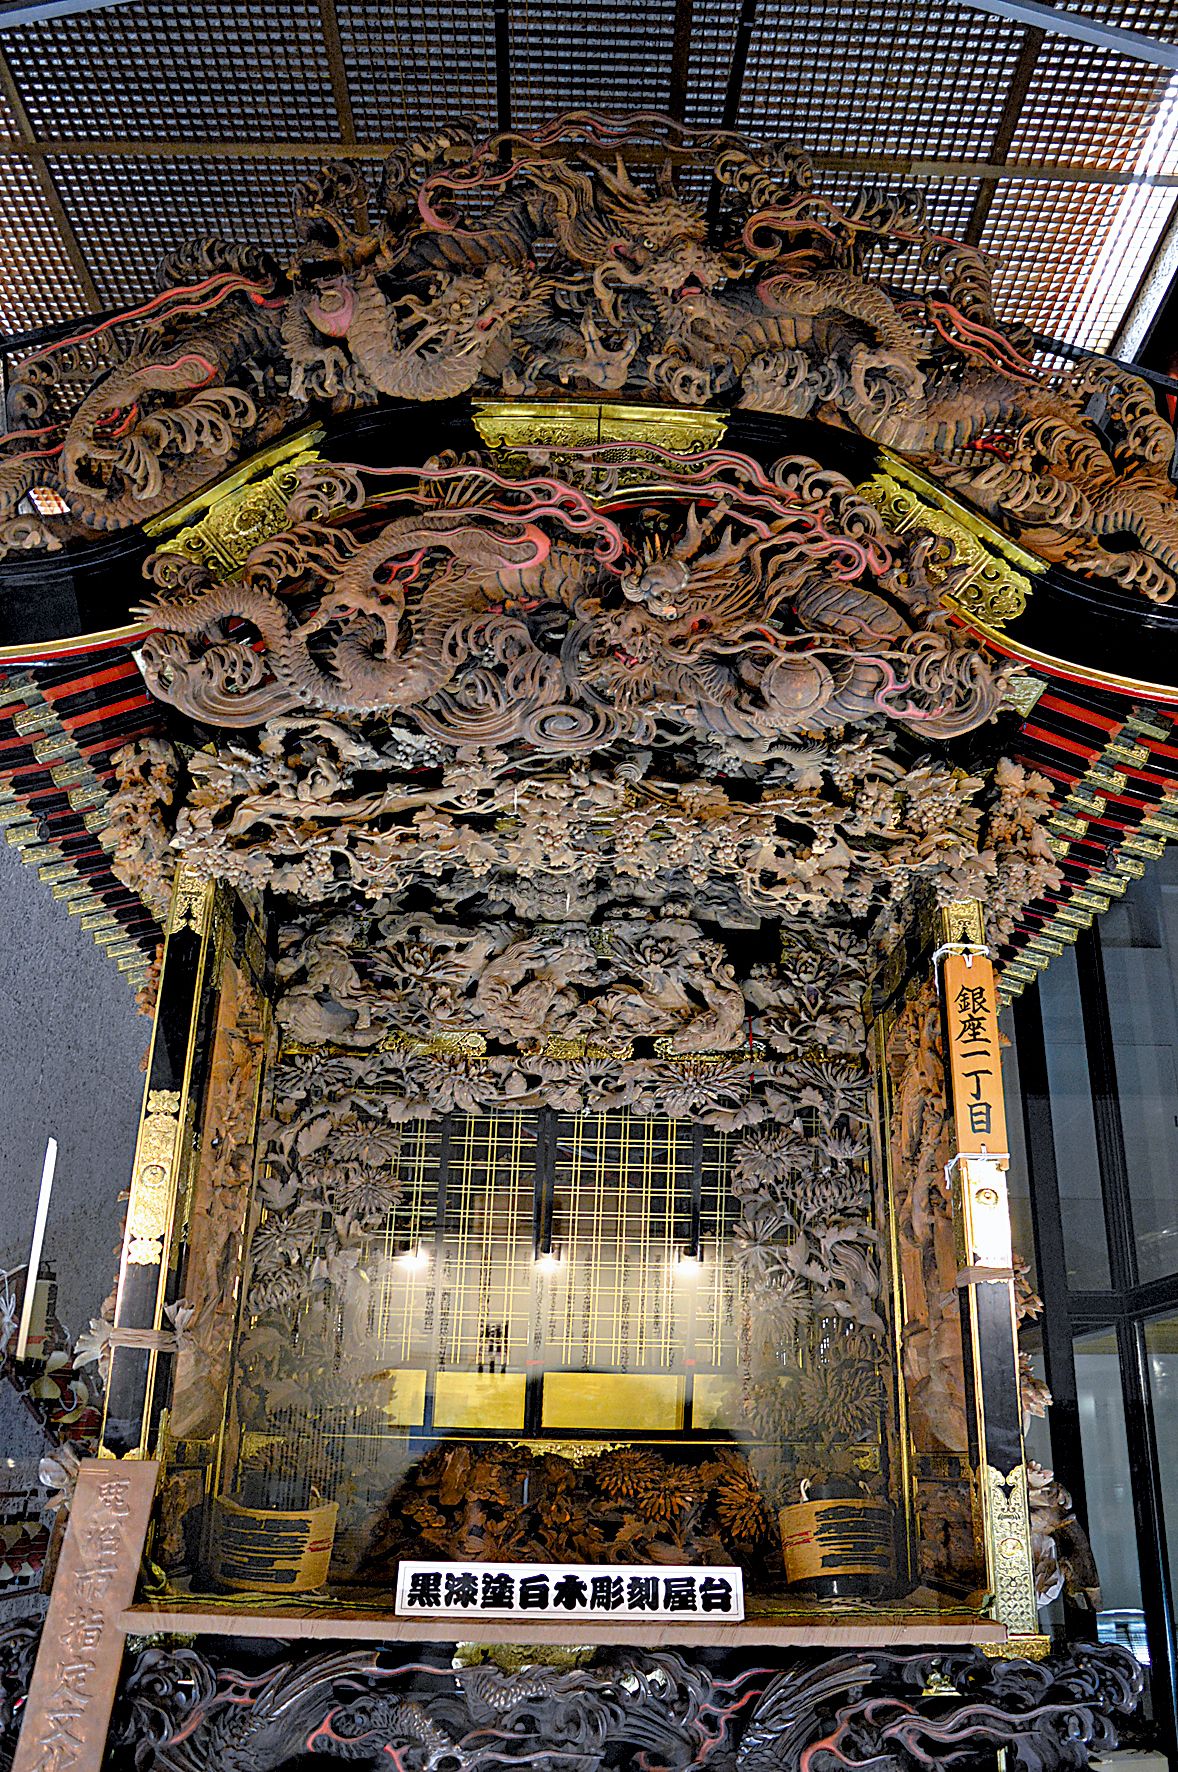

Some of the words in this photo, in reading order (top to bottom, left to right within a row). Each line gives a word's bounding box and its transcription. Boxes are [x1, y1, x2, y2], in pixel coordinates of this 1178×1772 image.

[954, 984, 993, 1135] 銀座一丁目
[407, 1572, 733, 1612] 黒漆塗白木彫刻屋台
